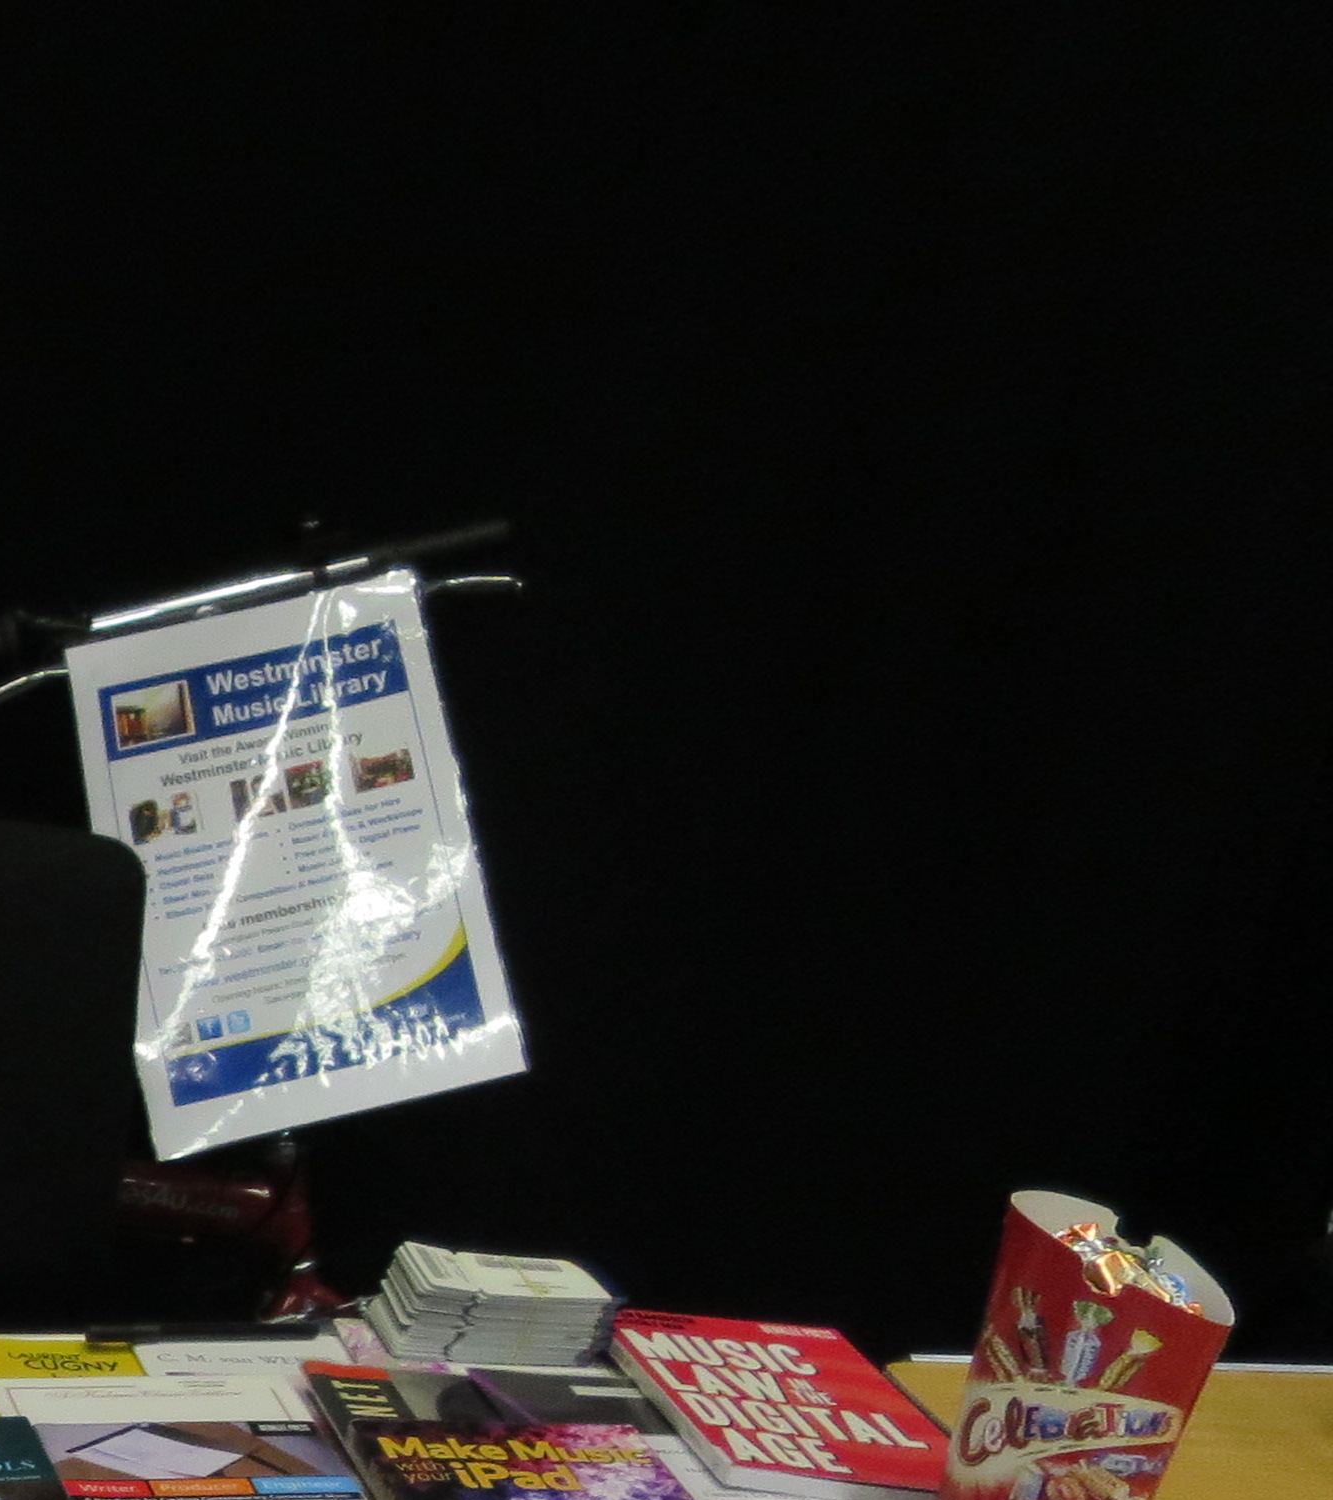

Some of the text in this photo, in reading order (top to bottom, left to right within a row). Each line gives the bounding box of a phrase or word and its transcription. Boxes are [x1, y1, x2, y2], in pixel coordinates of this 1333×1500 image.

[620, 1328, 817, 1375] MUSIC
[23, 1359, 119, 1372] CUGNY
[648, 1359, 814, 1403] LAW IN
[680, 1391, 931, 1449] DIGITAL
[378, 1437, 653, 1464] Make Music
[723, 1427, 854, 1474] AGE
[396, 1461, 446, 1472] with
[402, 1473, 453, 1483] your
[453, 1463, 583, 1490] iPad
[79, 1483, 135, 1493] Writer
